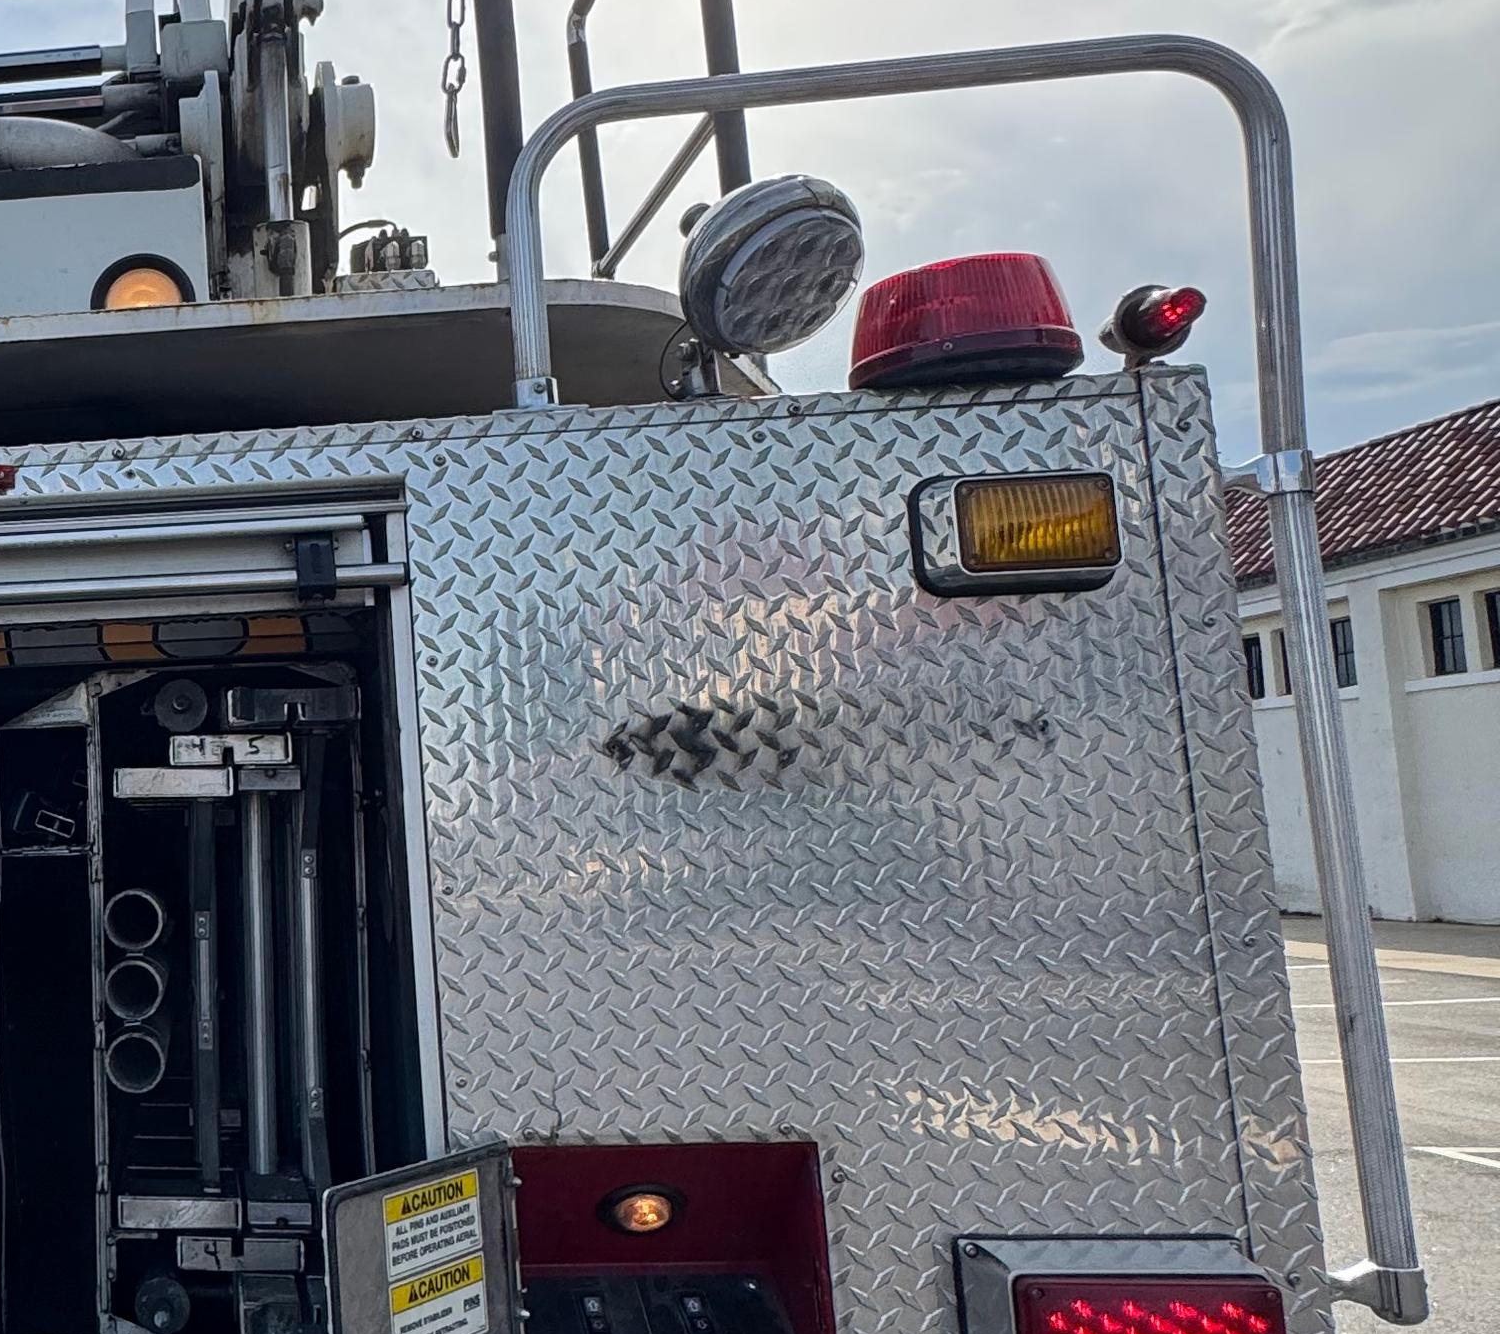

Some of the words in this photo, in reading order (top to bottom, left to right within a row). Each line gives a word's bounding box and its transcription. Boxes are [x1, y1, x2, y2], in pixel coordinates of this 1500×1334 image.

[411, 1180, 464, 1211] CAUTION
[392, 1237, 410, 1251] PADS
[411, 1231, 428, 1245] MUST
[430, 1228, 439, 1238] BE
[440, 1215, 475, 1234] POSITIONED
[396, 1226, 408, 1236] ALL
[410, 1218, 424, 1230] PINS
[426, 1214, 439, 1225] AND
[440, 1203, 470, 1220] AUXILIARY
[392, 1250, 418, 1267] BEFORE
[420, 1236, 455, 1256] OPERATING
[456, 1229, 477, 1243] AERIAL
[419, 1264, 470, 1299] CAUTION
